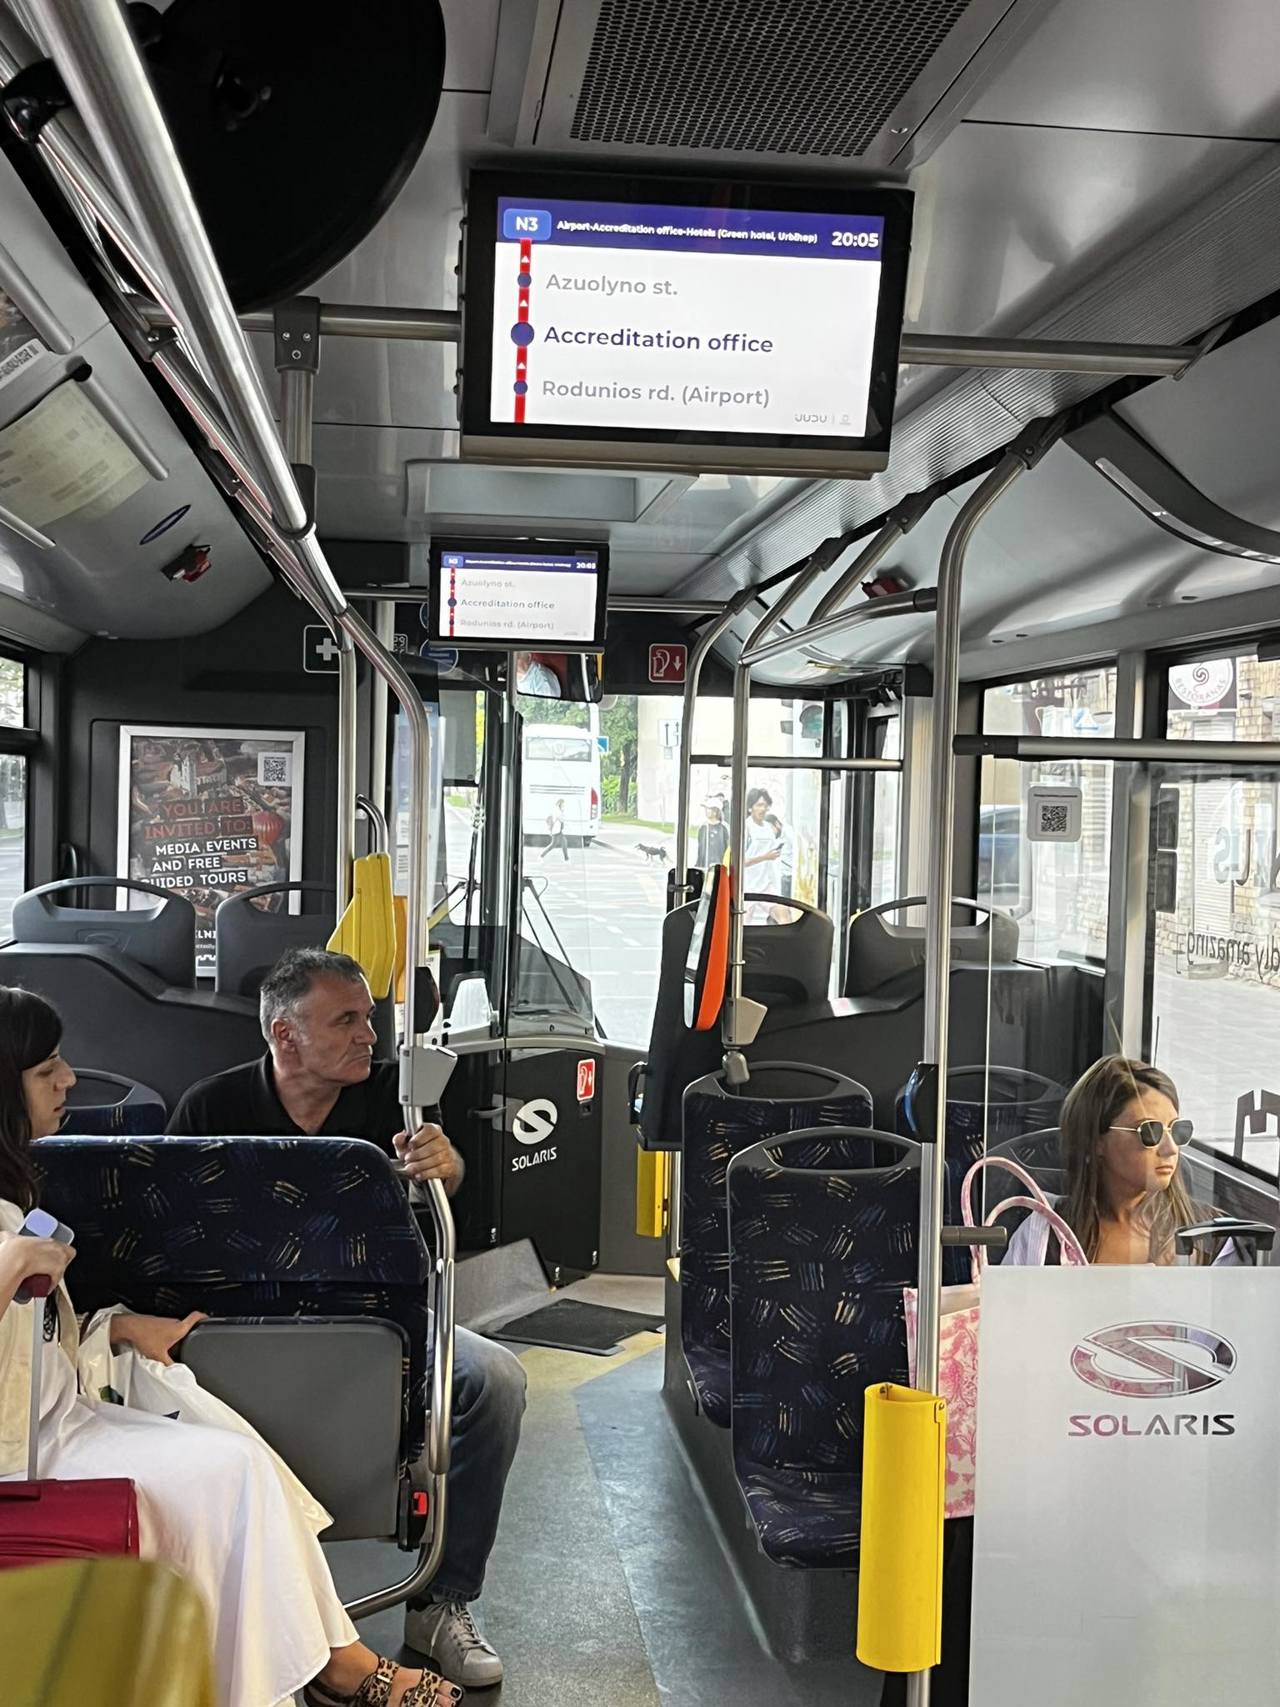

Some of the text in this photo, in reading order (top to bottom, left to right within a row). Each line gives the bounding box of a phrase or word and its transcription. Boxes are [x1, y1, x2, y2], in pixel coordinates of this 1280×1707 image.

[515, 216, 538, 232] N3
[557, 220, 655, 235] Airport-Accreditation
[656, 225, 716, 237] office-Hotels
[718, 229, 748, 240] (Green
[750, 230, 776, 242] hotel,
[831, 231, 880, 248] 20:05
[546, 273, 678, 296] Azuolyno st.
[543, 326, 774, 353] Accreditation office
[542, 380, 770, 409] Rodunios rd. (Airport)
[461, 578, 503, 589] Azuolyno
[460, 598, 555, 610] Accreditation office
[517, 620, 555, 631] (Airport)
[163, 801, 242, 817] YOU ARE
[144, 821, 215, 840] INVITED
[155, 838, 257, 856] MEDIA EVENTS
[152, 857, 221, 873] AND FREE
[140, 871, 247, 889] UIDED TOURS
[511, 1146, 558, 1172] SOLARIS
[1067, 1414, 1236, 1437] SOLARIS
